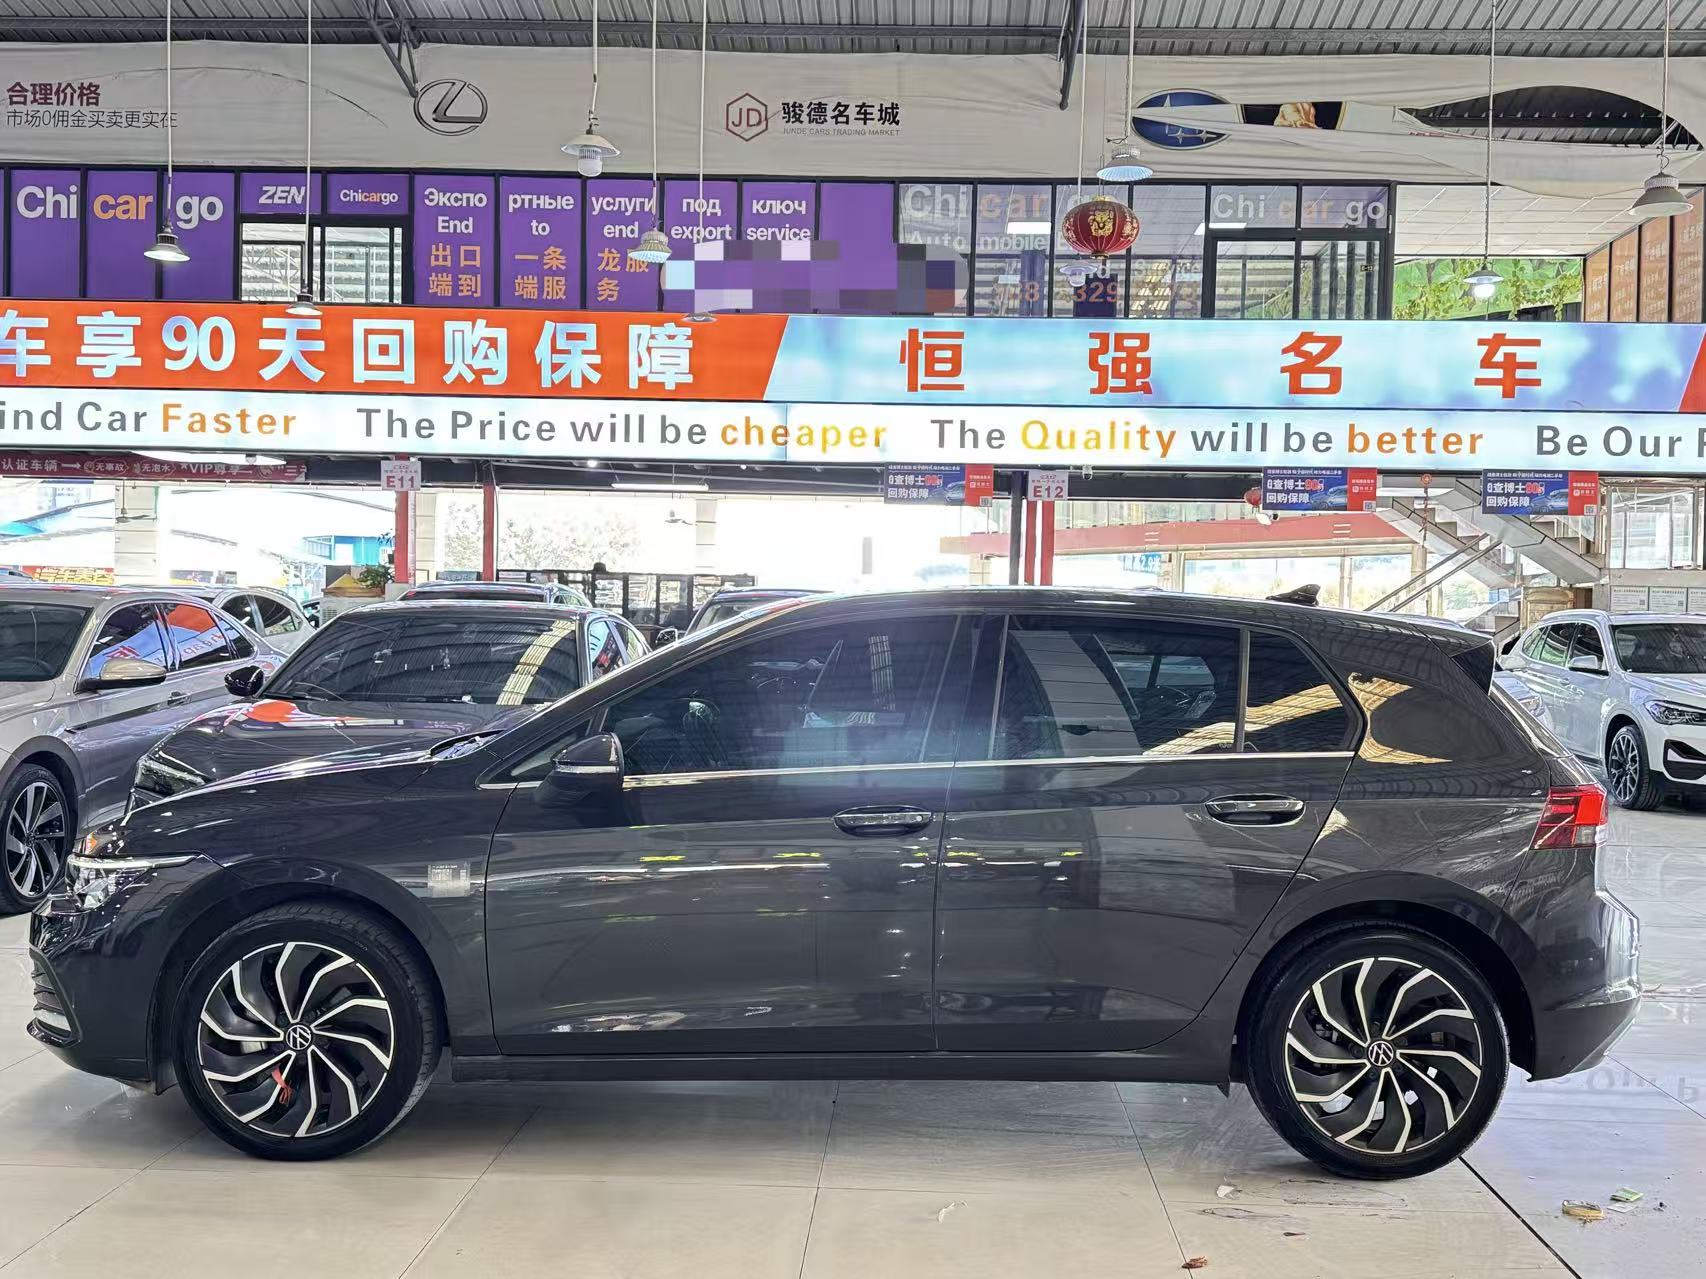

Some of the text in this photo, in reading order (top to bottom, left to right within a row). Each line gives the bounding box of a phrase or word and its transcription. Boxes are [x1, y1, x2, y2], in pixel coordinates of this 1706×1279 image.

[7, 82, 100, 106] 合理价格
[7, 110, 177, 128] 市场0佣金买卖更实在
[731, 107, 763, 128] JD
[781, 101, 900, 125] 骏德名车城
[810, 128, 830, 136] CARS
[258, 186, 306, 204] ZEN
[340, 189, 399, 206] Chicargo
[424, 187, 807, 217] Экспо ртные услуги под ключ
[903, 184, 968, 219] Chi
[16, 185, 224, 230] Chi car go
[1213, 194, 1265, 219] Chi
[1345, 200, 1386, 225] go
[437, 216, 812, 243] End to end export service
[983, 233, 1047, 251] mobile
[430, 243, 481, 268] 出口
[514, 245, 566, 271] 一条
[428, 272, 620, 302] 端到 端服 务
[0, 309, 694, 391] 车享90天回购保障
[899, 327, 1542, 399] 恒强名车
[77, 401, 147, 433] Car
[162, 402, 297, 436] Faster
[356, 407, 436, 440] The
[450, 409, 557, 443] Price
[569, 412, 646, 444] will
[659, 414, 708, 445] be
[720, 415, 888, 454] cheaper
[929, 418, 1007, 450] The
[1021, 419, 1177, 459] Quality
[1190, 422, 1268, 453] will
[1283, 423, 1334, 454] be
[1347, 423, 1485, 455] better
[1536, 425, 1589, 457] Be
[1603, 425, 1683, 458] Our
[386, 475, 415, 489] E11
[887, 488, 930, 499] 回购保障
[1033, 485, 1064, 499] E12
[1265, 492, 1311, 504] 回购保障
[1485, 496, 1531, 508] 回购保障
